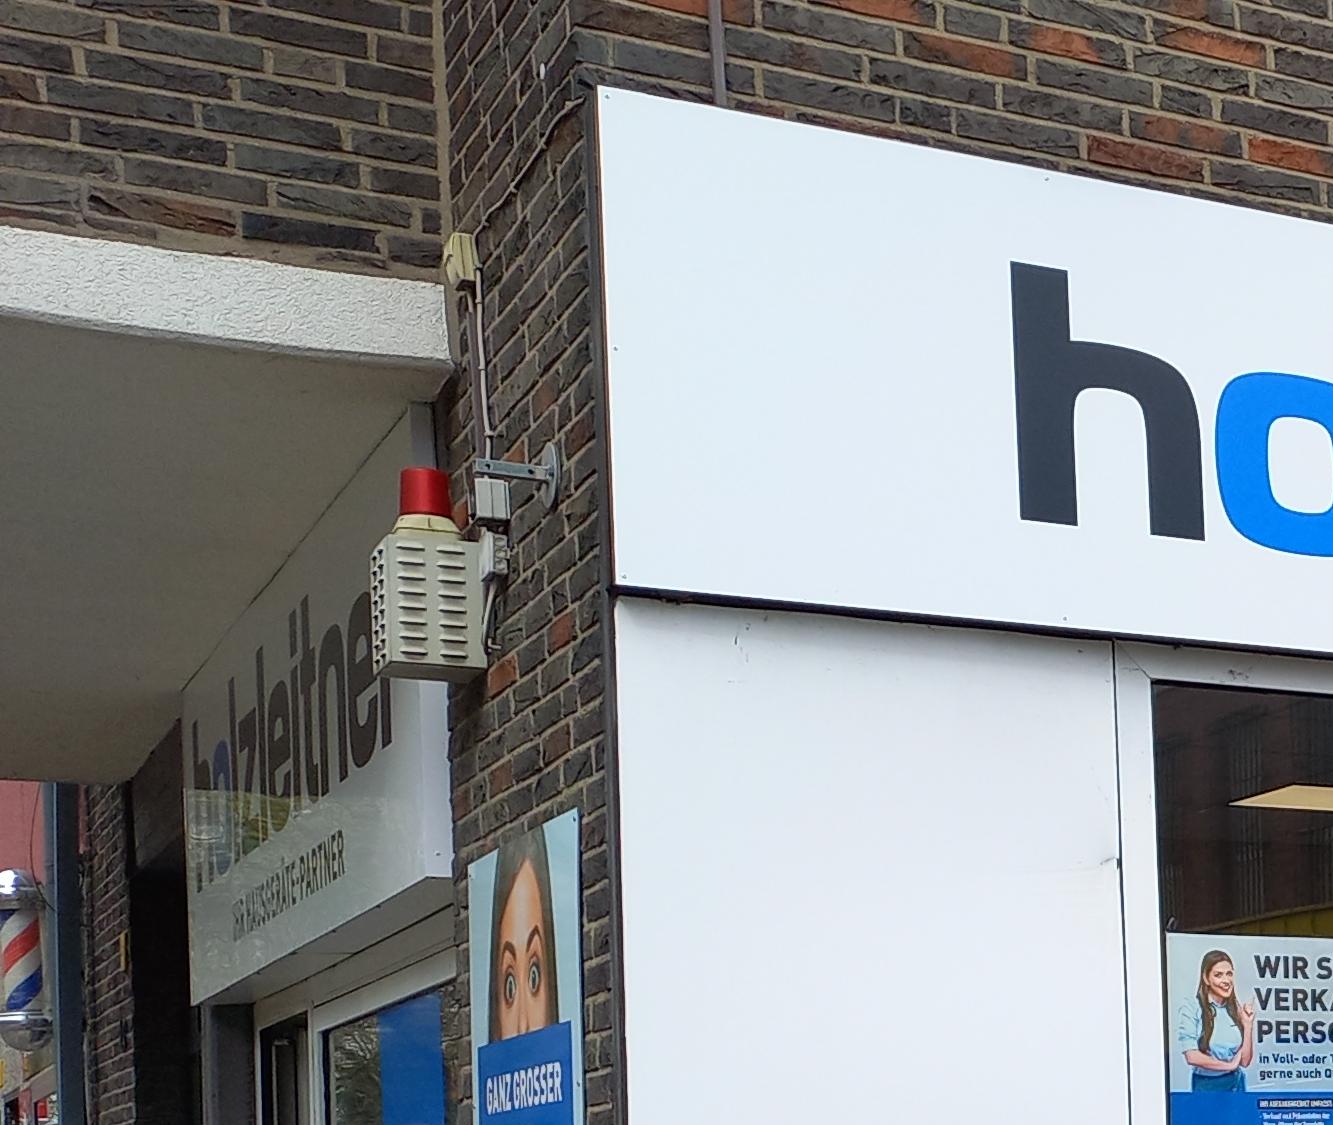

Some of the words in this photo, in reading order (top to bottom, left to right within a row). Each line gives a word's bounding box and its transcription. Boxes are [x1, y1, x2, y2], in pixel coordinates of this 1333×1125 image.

[1254, 955, 1309, 980] WIR
[1259, 1053, 1269, 1064] in
[1259, 1069, 1293, 1080] gerne
[1296, 1068, 1321, 1079] auch
[486, 1073, 512, 1115] GANZ
[513, 1061, 563, 1110] GROSSER
